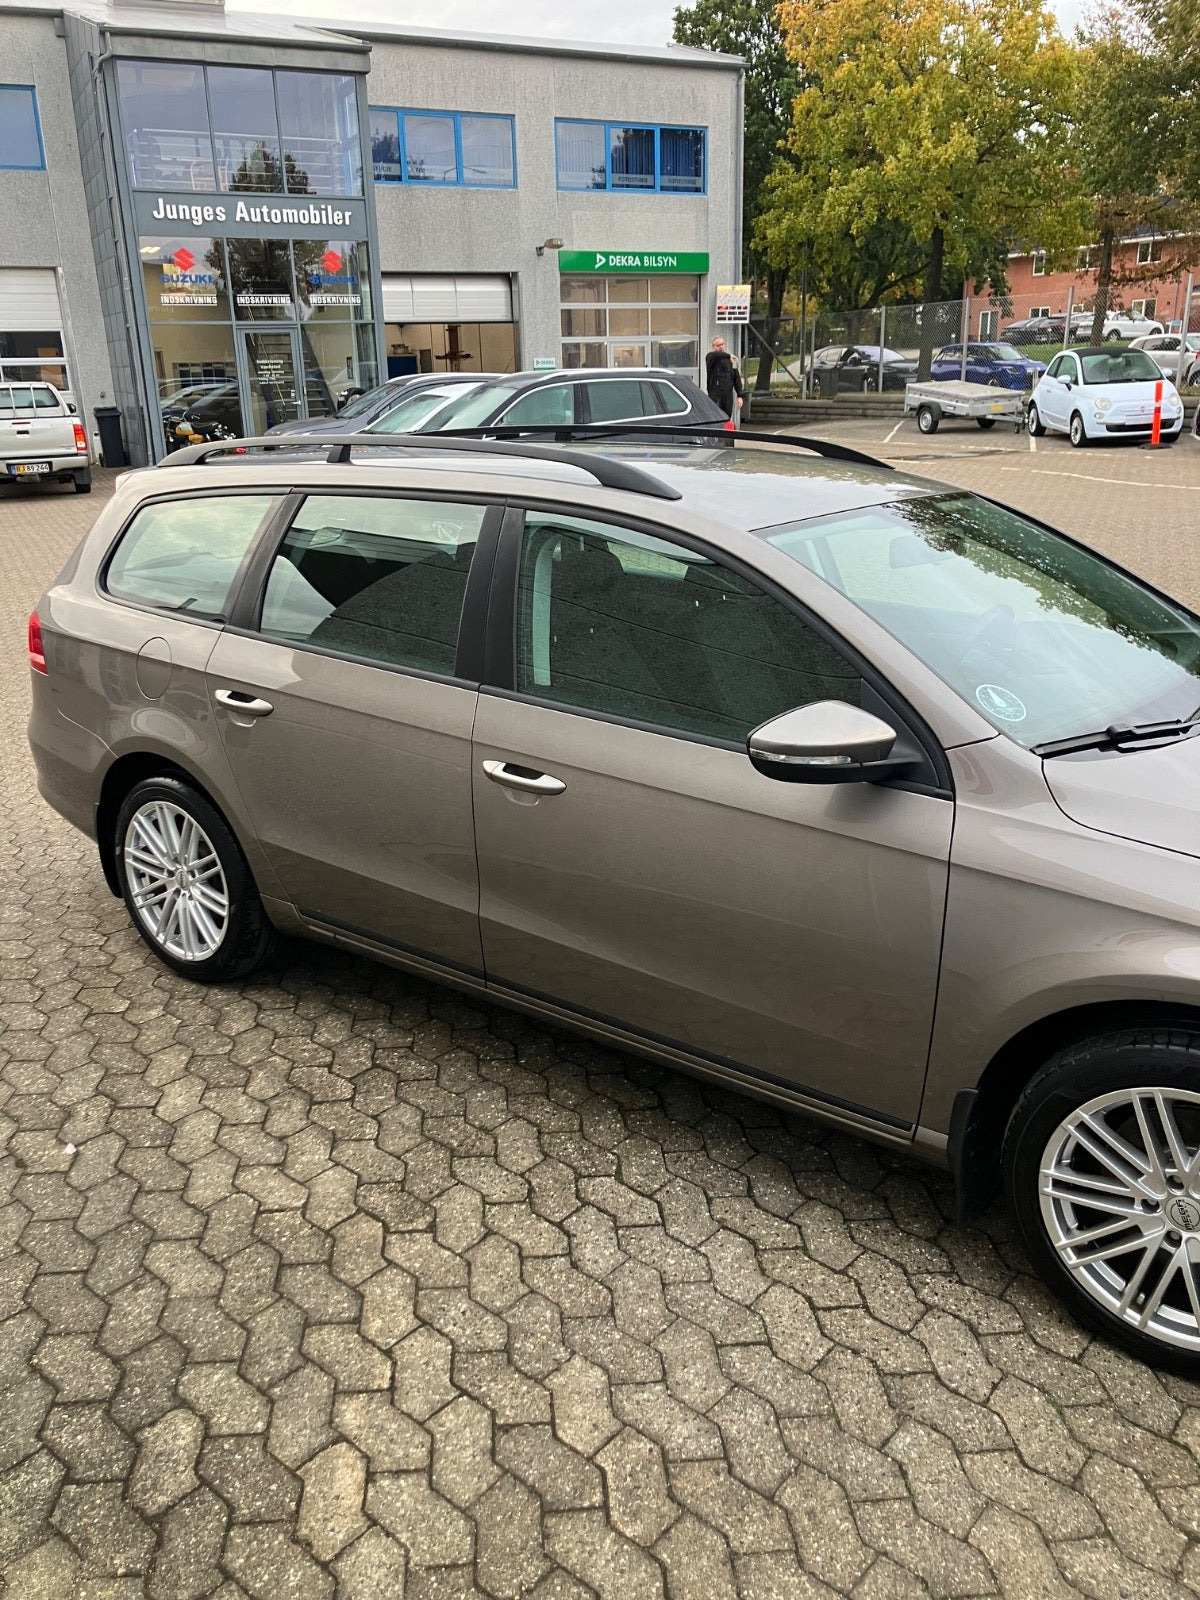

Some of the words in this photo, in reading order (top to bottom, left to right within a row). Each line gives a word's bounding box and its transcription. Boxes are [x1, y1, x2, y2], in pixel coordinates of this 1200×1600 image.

[152, 197, 226, 226] Junges
[235, 200, 353, 226] Automobiler
[608, 255, 641, 267] DEKRA
[643, 255, 677, 267] BILSYN
[161, 273, 214, 284] SUZUKI
[160, 295, 218, 304] INDSKRIVNING
[236, 295, 291, 304] INDSKRIVNING
[309, 295, 361, 304] INDSKRIVNING
